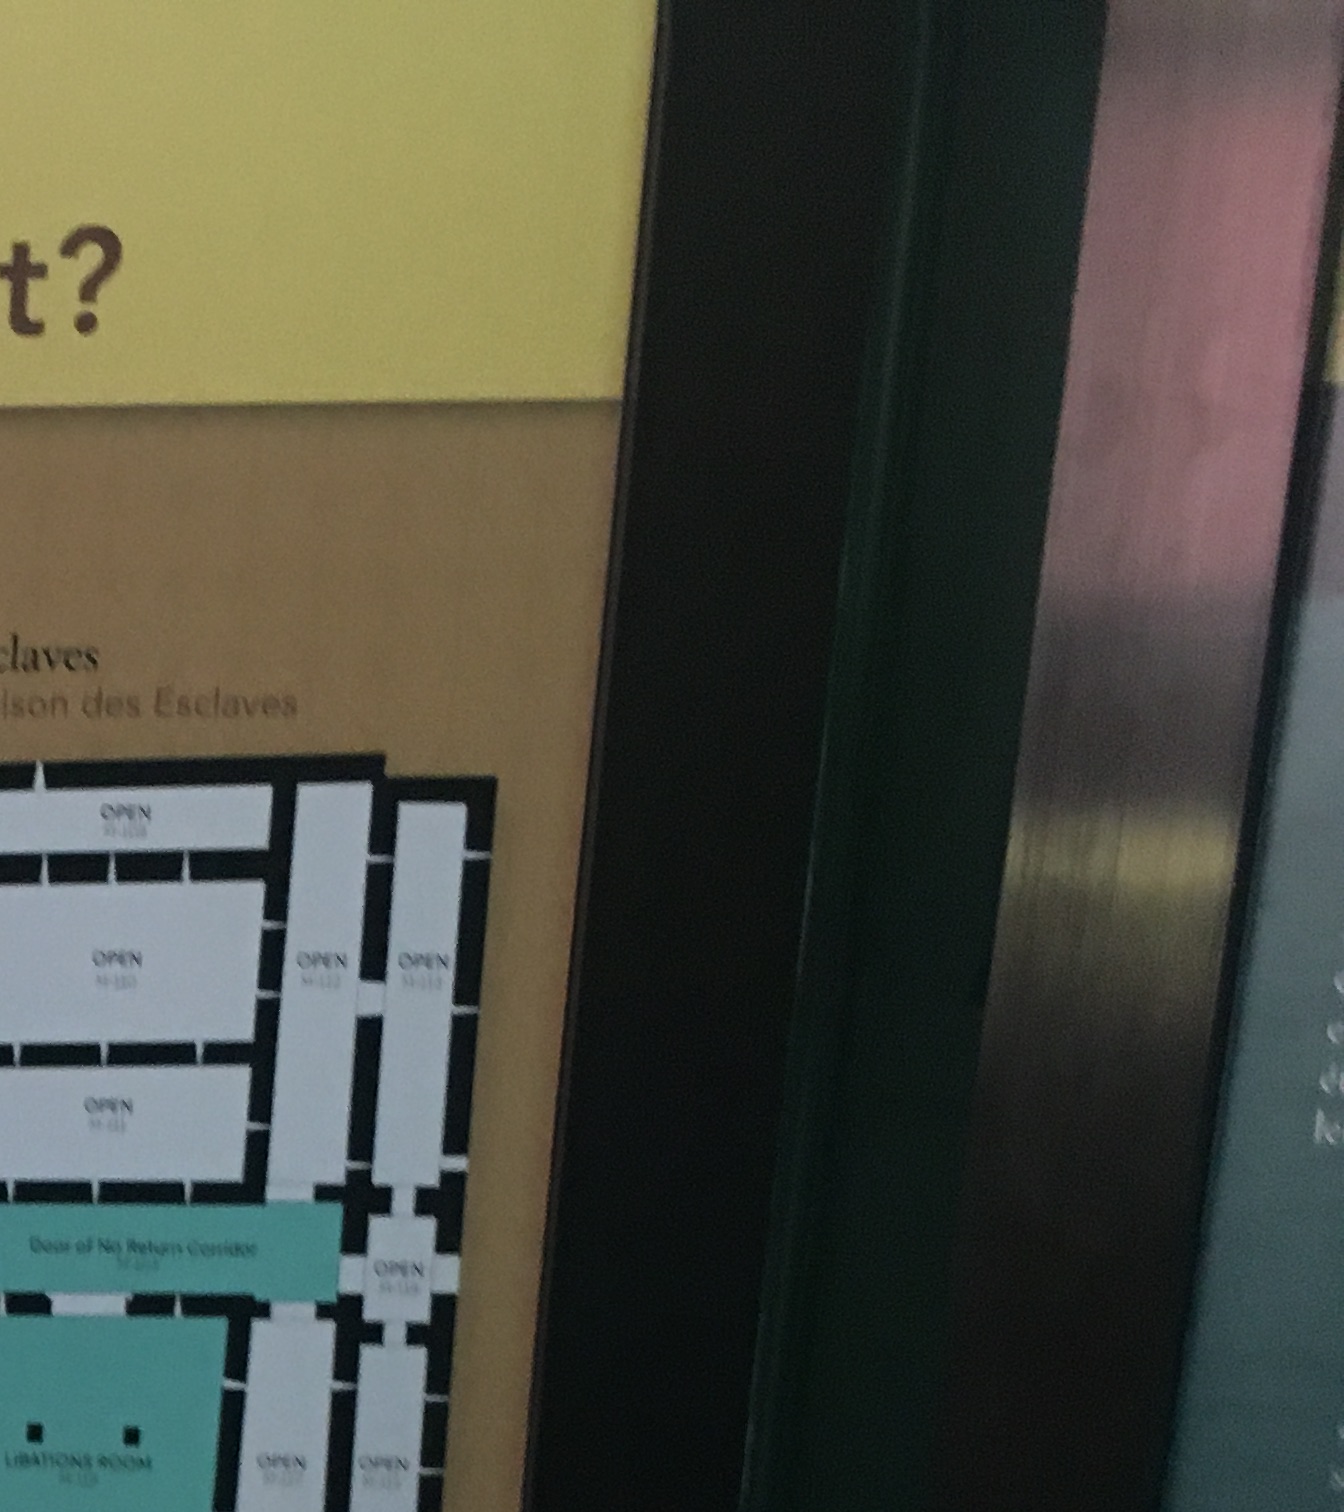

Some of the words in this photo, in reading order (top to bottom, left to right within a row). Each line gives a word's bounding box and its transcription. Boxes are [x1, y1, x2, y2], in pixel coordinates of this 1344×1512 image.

[80, 686, 142, 719] des
[152, 686, 299, 719] Esclaves
[99, 804, 153, 823] OPEN
[92, 950, 143, 969] OPEN
[295, 951, 349, 971] OPEN
[397, 951, 449, 971] OPEN
[84, 1097, 133, 1116] OPEN
[373, 1260, 424, 1279] OPEN
[257, 1453, 307, 1472] OPEN
[359, 1454, 409, 1472] OPEN
